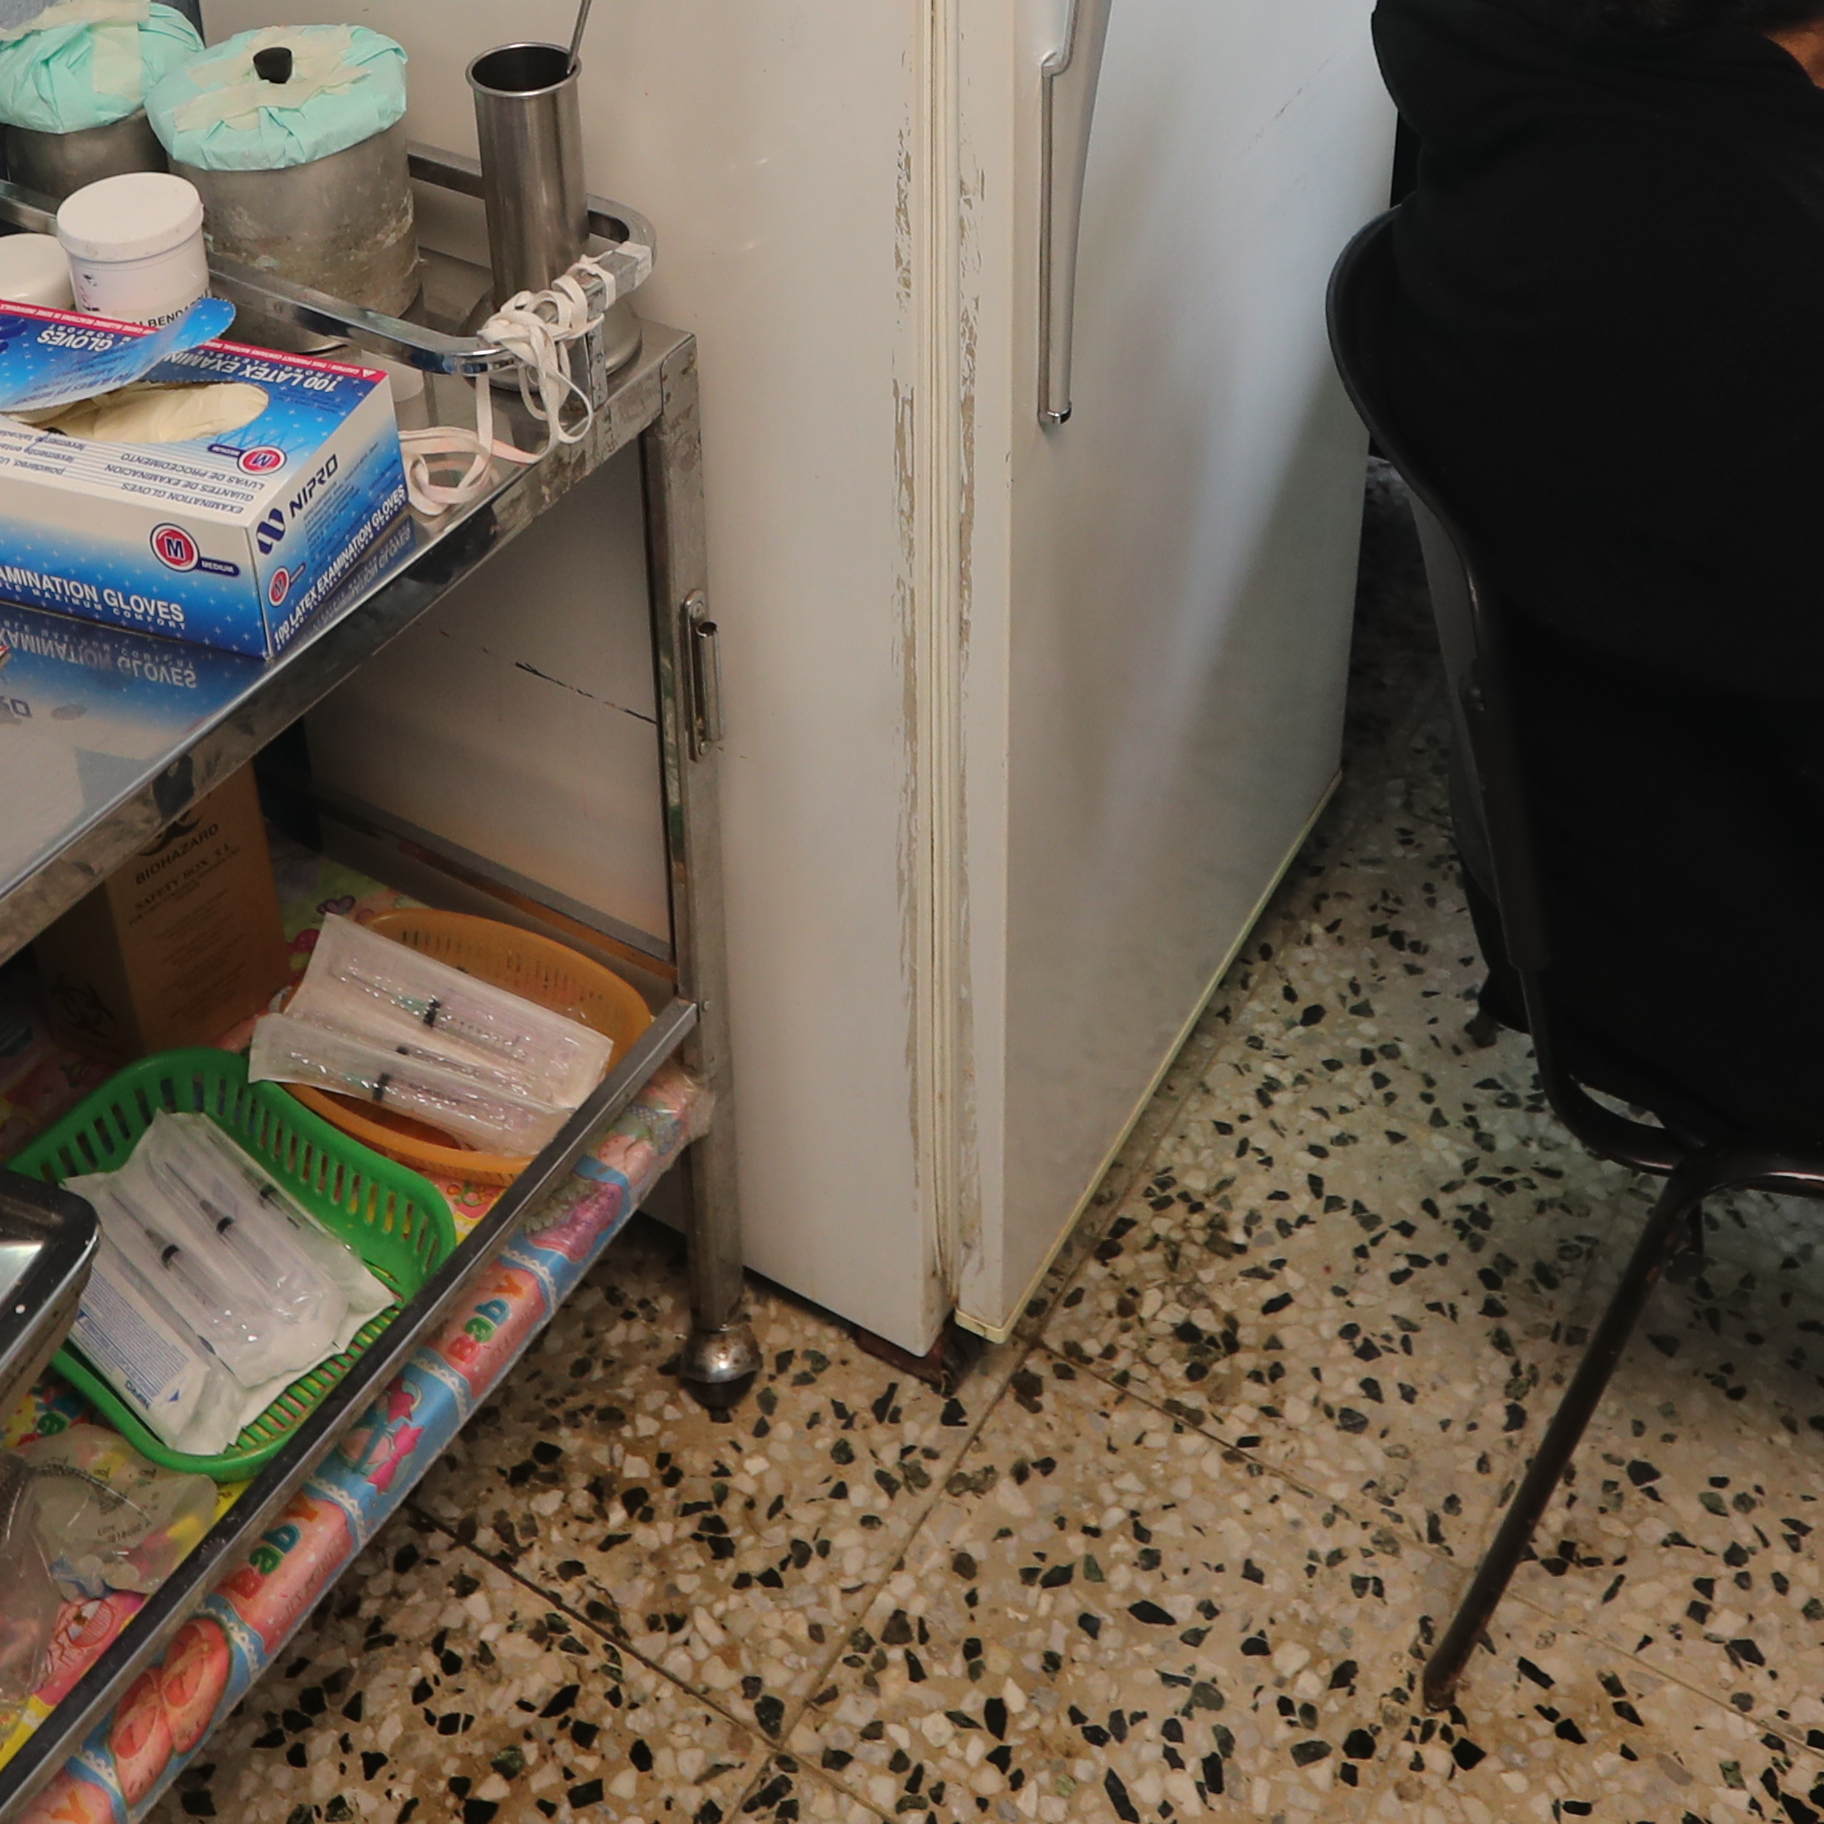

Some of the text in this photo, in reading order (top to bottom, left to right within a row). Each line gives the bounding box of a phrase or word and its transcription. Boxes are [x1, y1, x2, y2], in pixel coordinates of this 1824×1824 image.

[37, 329, 113, 353] GLOVES
[241, 362, 304, 387] LATEX
[303, 371, 341, 393] 100
[119, 452, 266, 491] LUVAS DE PROCEDIMENTO
[251, 453, 273, 467] M
[103, 463, 256, 503] GUANTES DE EXAMINACION
[120, 482, 245, 514] EXAMINATION GLOVES
[287, 452, 339, 519] NIPRO
[166, 536, 186, 560] M
[274, 483, 406, 646] 100 LATEX EXAMINATION GLOVES
[200, 559, 235, 575] MEDIUM
[32, 587, 104, 611] MAXIMUM
[112, 607, 186, 631] COMFORT
[102, 587, 186, 623] GLOVES
[135, 823, 219, 885] BIOHAZARD
